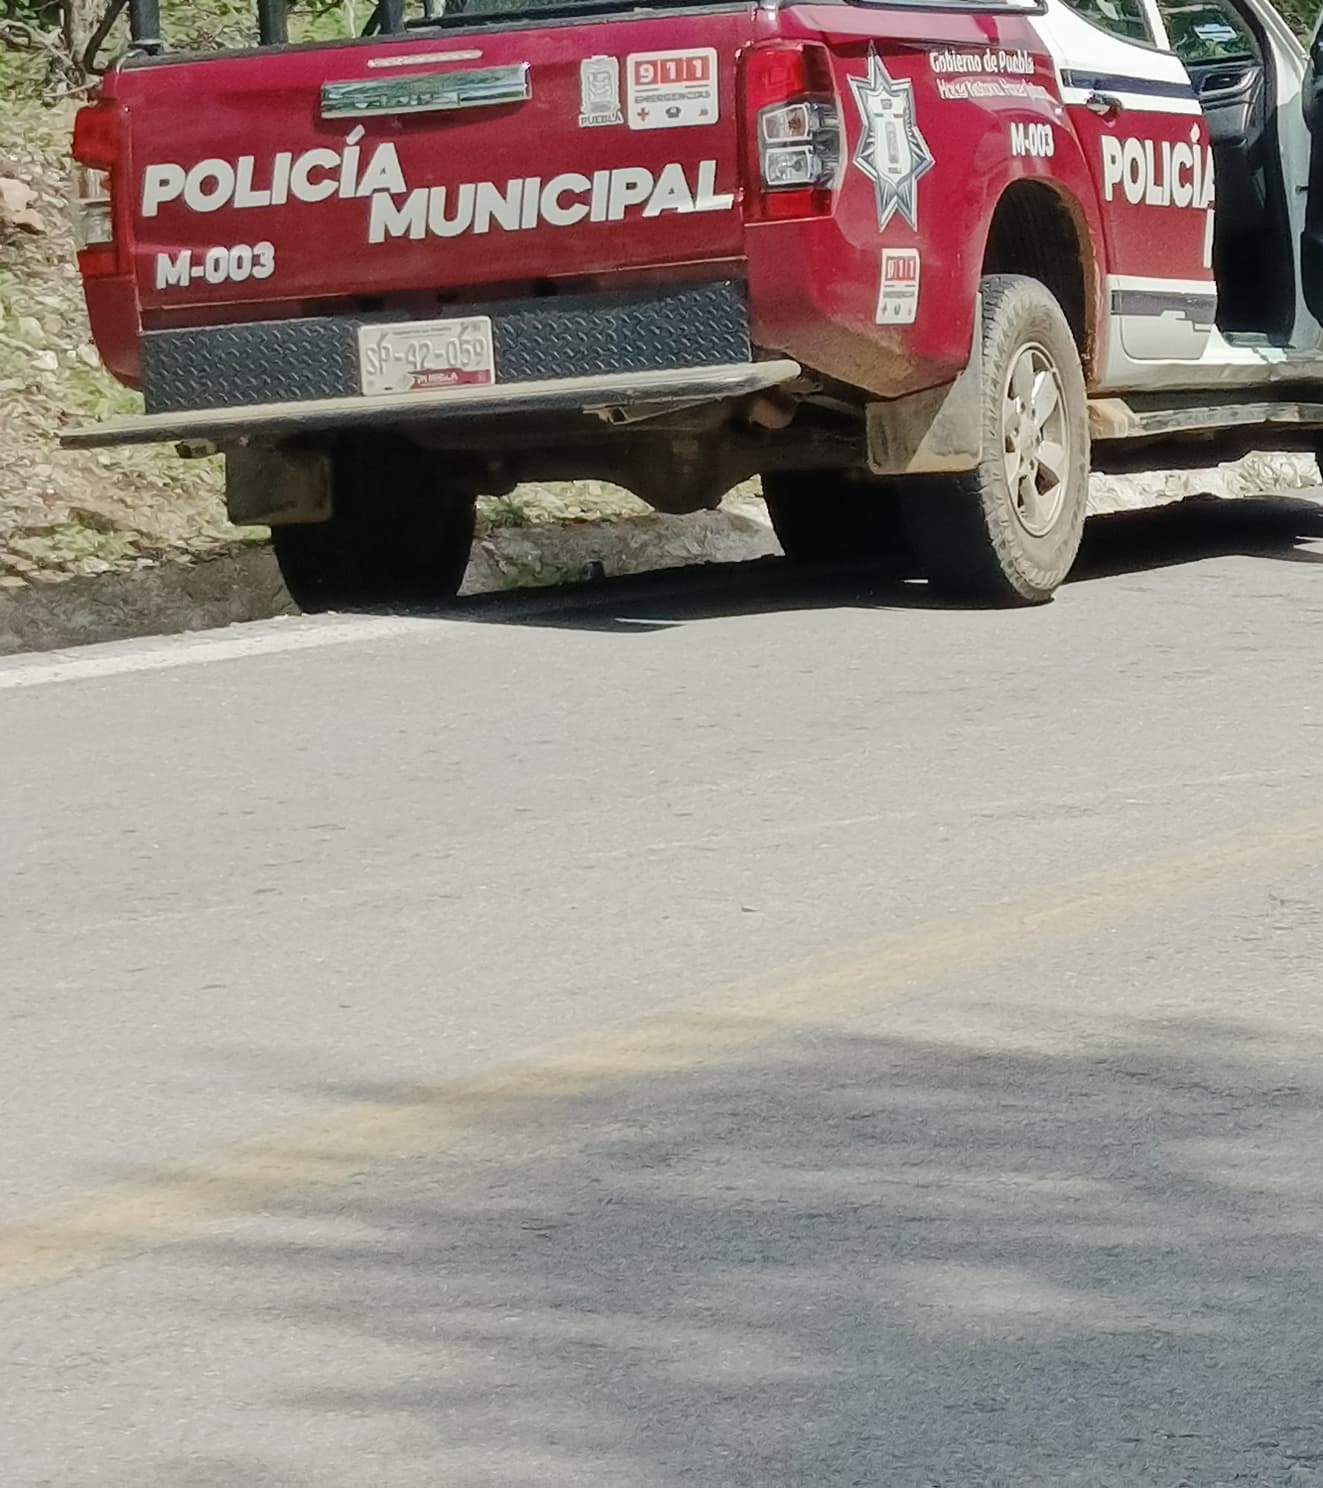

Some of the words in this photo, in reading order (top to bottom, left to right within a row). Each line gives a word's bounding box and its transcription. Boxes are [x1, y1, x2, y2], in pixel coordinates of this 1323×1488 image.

[638, 58, 705, 85] 911
[929, 49, 981, 73] Gobierno
[983, 48, 998, 72] de
[580, 111, 622, 125] PUEBLA
[1010, 122, 1055, 158] M-003
[142, 124, 407, 217] POLICÍA
[368, 160, 734, 244] MUNICIPAL
[156, 241, 275, 290] M-003
